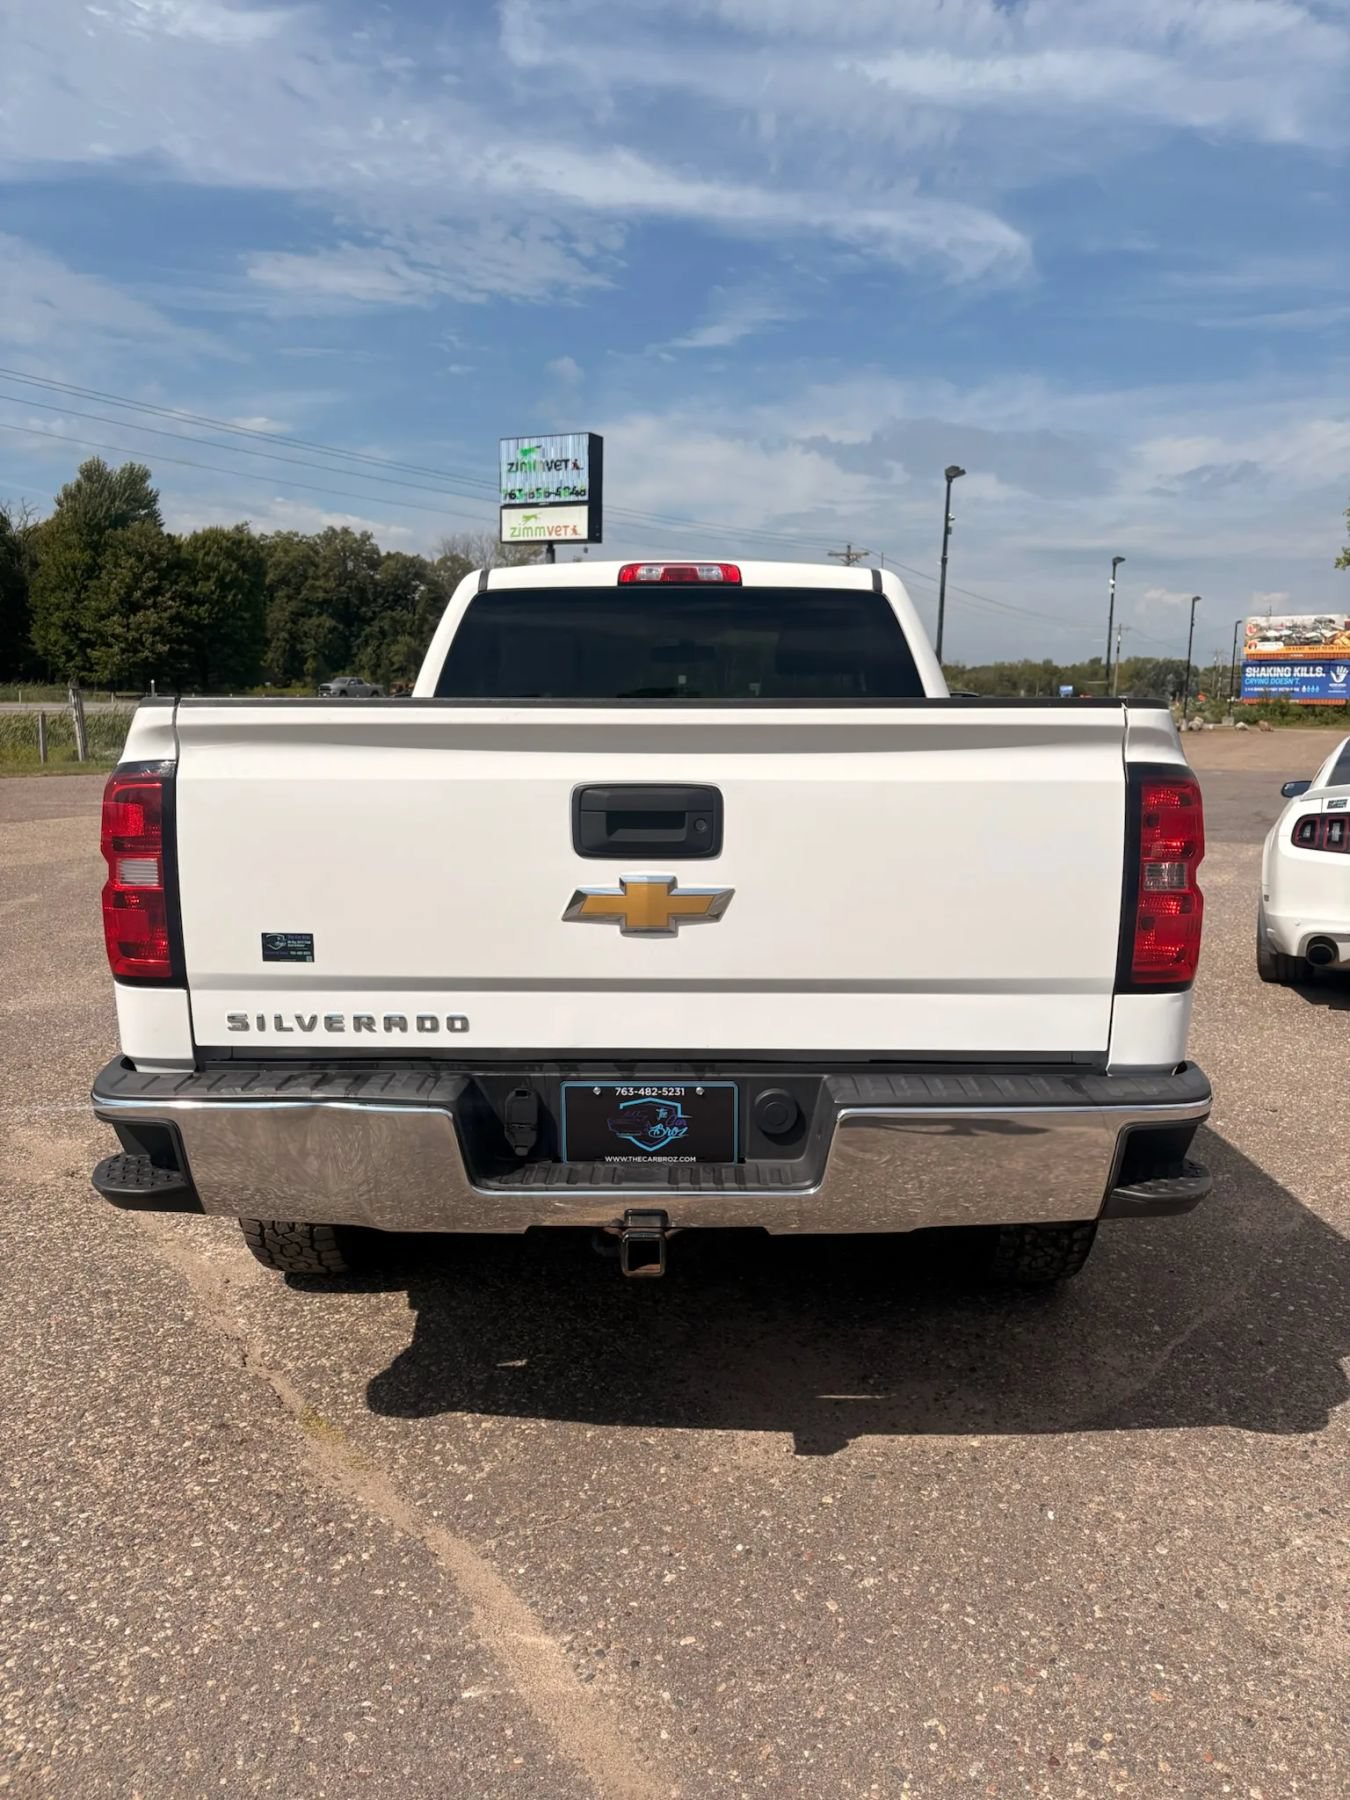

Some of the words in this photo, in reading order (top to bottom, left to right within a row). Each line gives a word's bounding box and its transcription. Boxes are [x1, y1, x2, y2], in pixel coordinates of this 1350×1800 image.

[1245, 666, 1291, 677] SHAKING
[1293, 666, 1326, 677] KILLS.
[226, 1012, 470, 1033] SILVERADO
[615, 1087, 685, 1096] 763-482-5231
